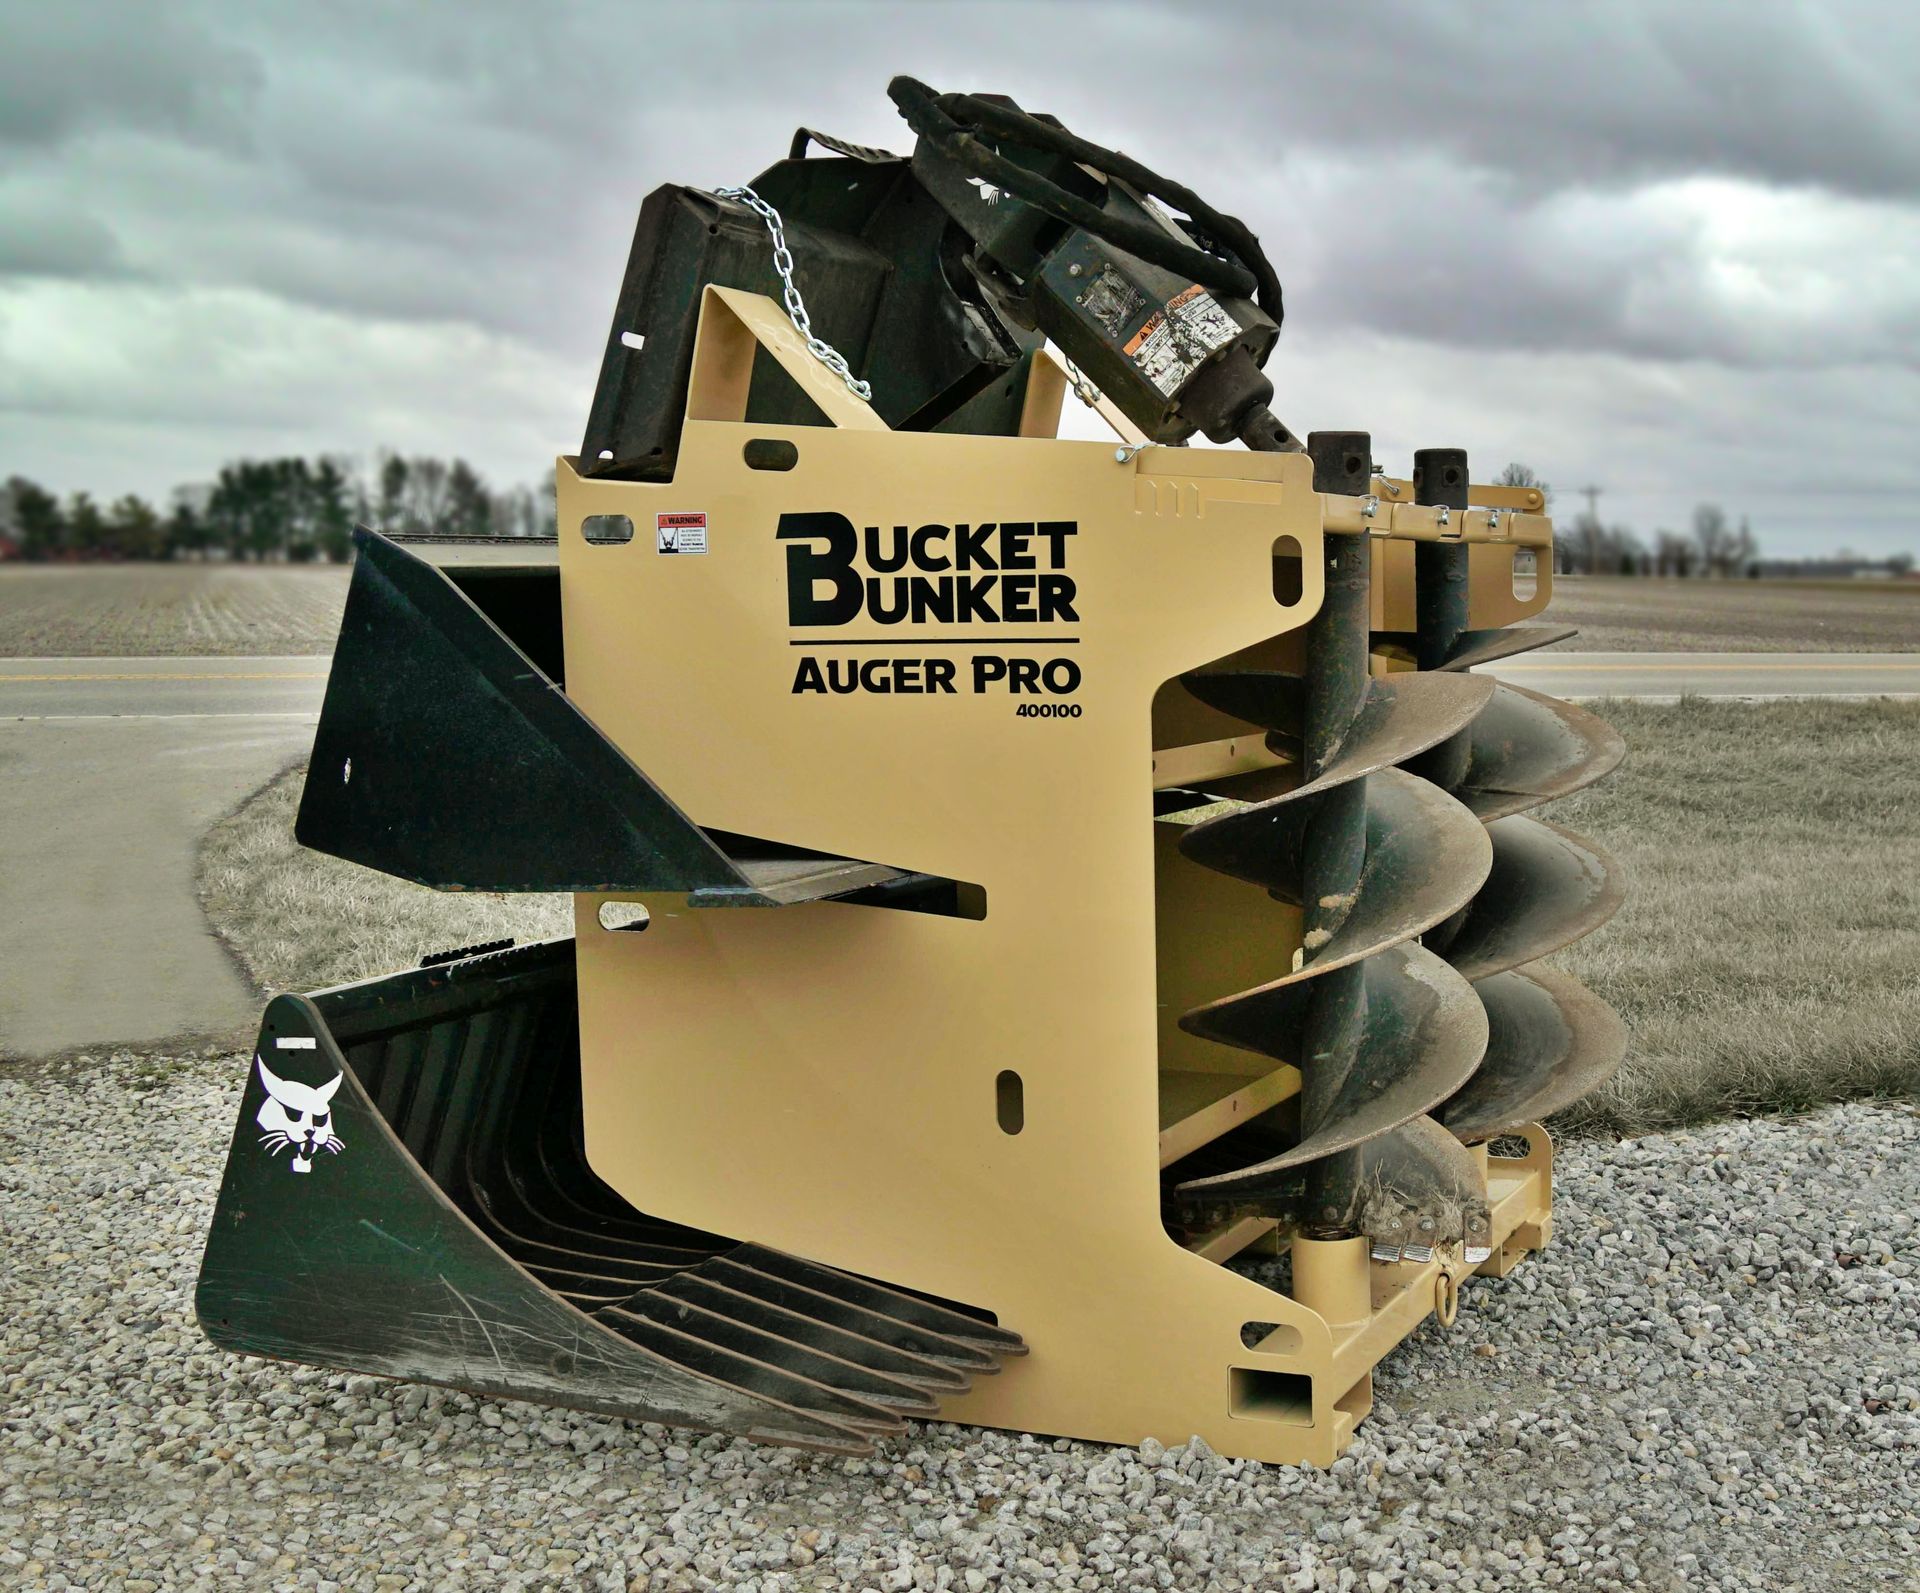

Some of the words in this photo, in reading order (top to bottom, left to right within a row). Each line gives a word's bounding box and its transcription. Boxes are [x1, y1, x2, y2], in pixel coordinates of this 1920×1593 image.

[668, 516, 702, 524] WARNING
[776, 511, 1077, 582] BUCKET
[791, 656, 958, 694] AUGER
[971, 655, 1081, 694] PRO
[1016, 703, 1082, 718] 400100
